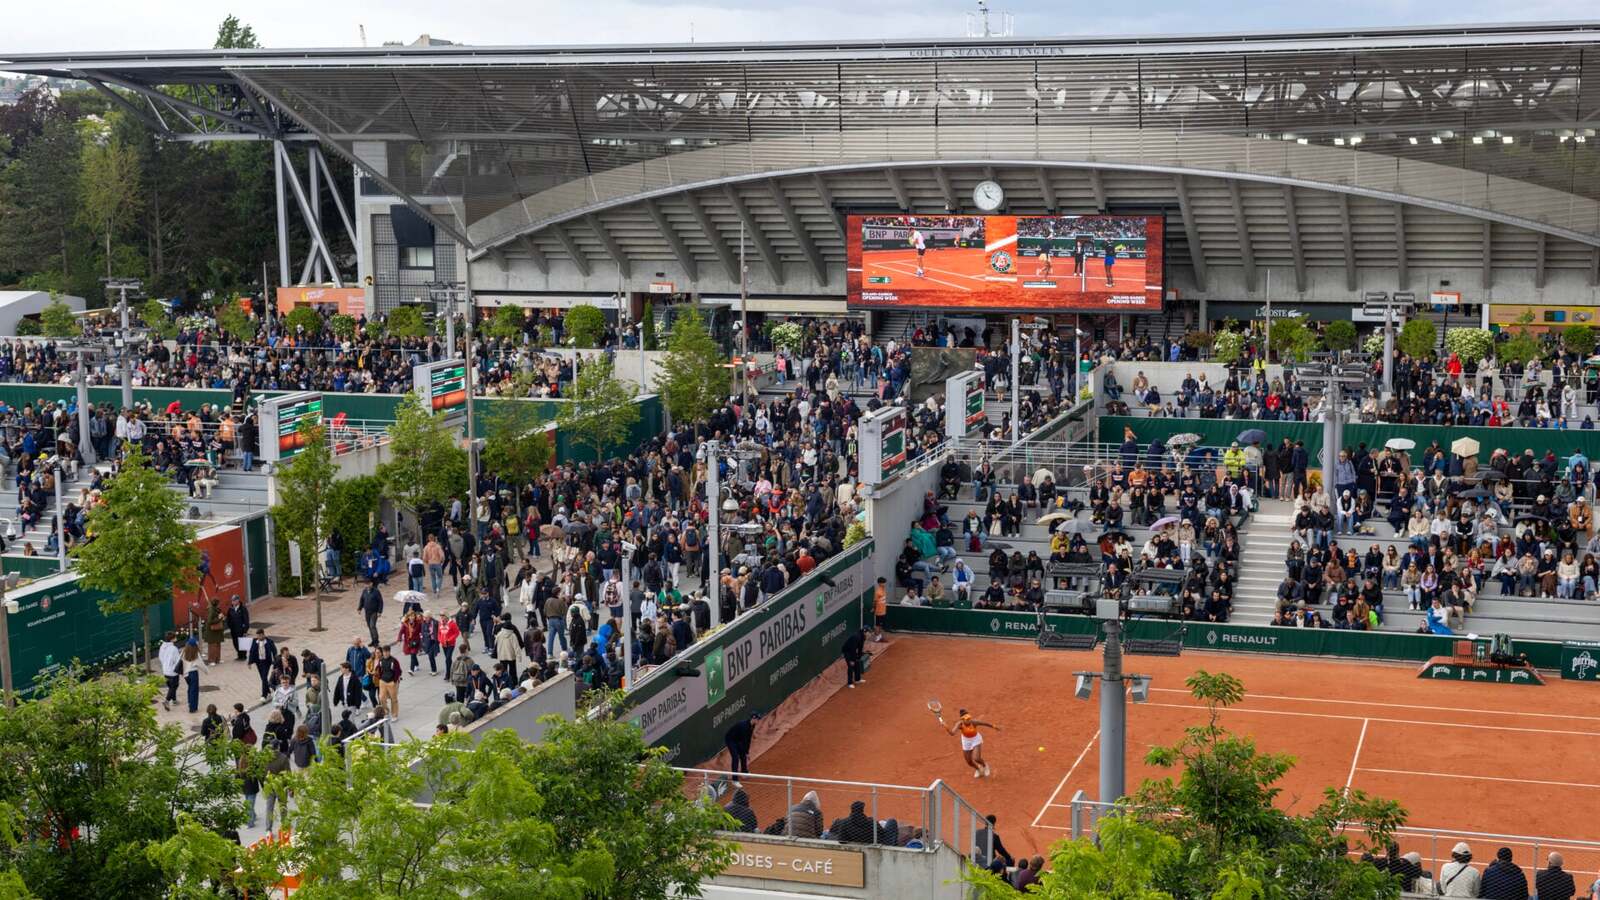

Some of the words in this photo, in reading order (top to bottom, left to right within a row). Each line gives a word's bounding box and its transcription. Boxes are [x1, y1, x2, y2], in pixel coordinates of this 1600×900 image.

[909, 49, 944, 57] COURT
[1255, 309, 1288, 317] LAOSTE
[1005, 621, 1057, 632] RENALT
[727, 640, 753, 682] BNP
[760, 604, 807, 660] PARIBAS
[1222, 634, 1278, 645] RENAULT
[641, 707, 657, 729] BNP
[658, 687, 687, 718] PARIBAS
[725, 695, 746, 722] PARIBAS
[791, 858, 833, 875] CAFÉ
